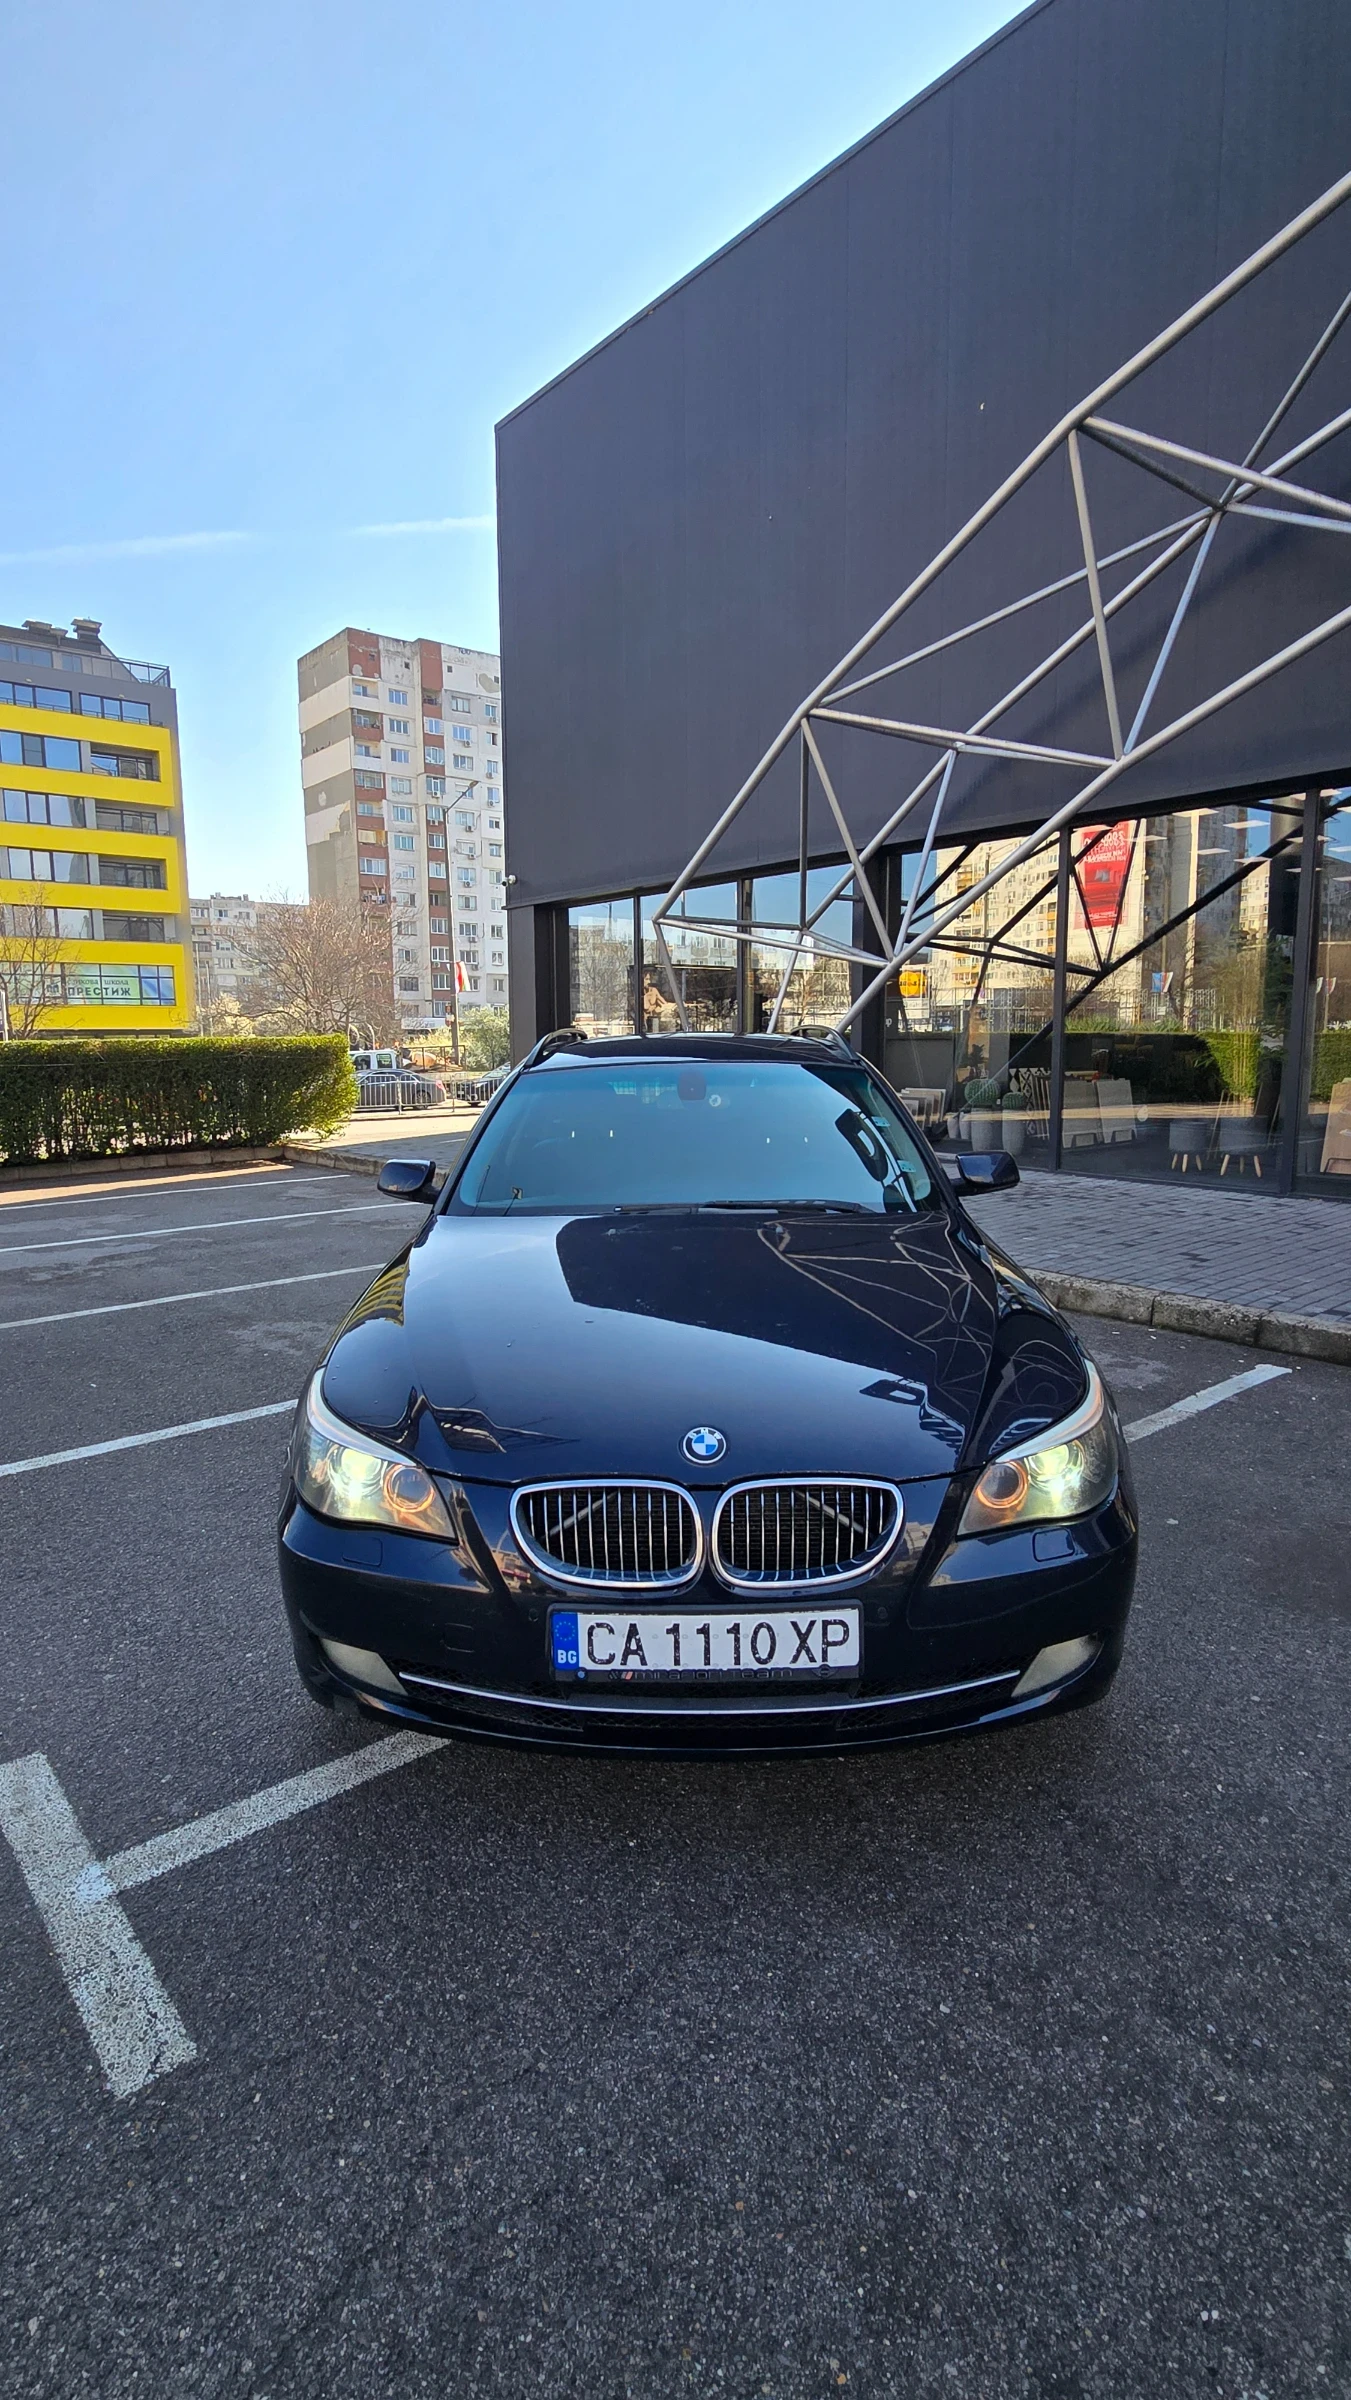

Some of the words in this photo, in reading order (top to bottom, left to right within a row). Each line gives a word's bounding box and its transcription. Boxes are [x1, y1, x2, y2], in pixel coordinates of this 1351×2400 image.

[68, 987, 131, 996] ПРЕСТИЖ
[688, 1428, 722, 1440] BMW
[587, 1622, 648, 1665] CA
[665, 1622, 777, 1665] 1110
[790, 1619, 850, 1663] XP
[557, 1649, 577, 1664] BG
